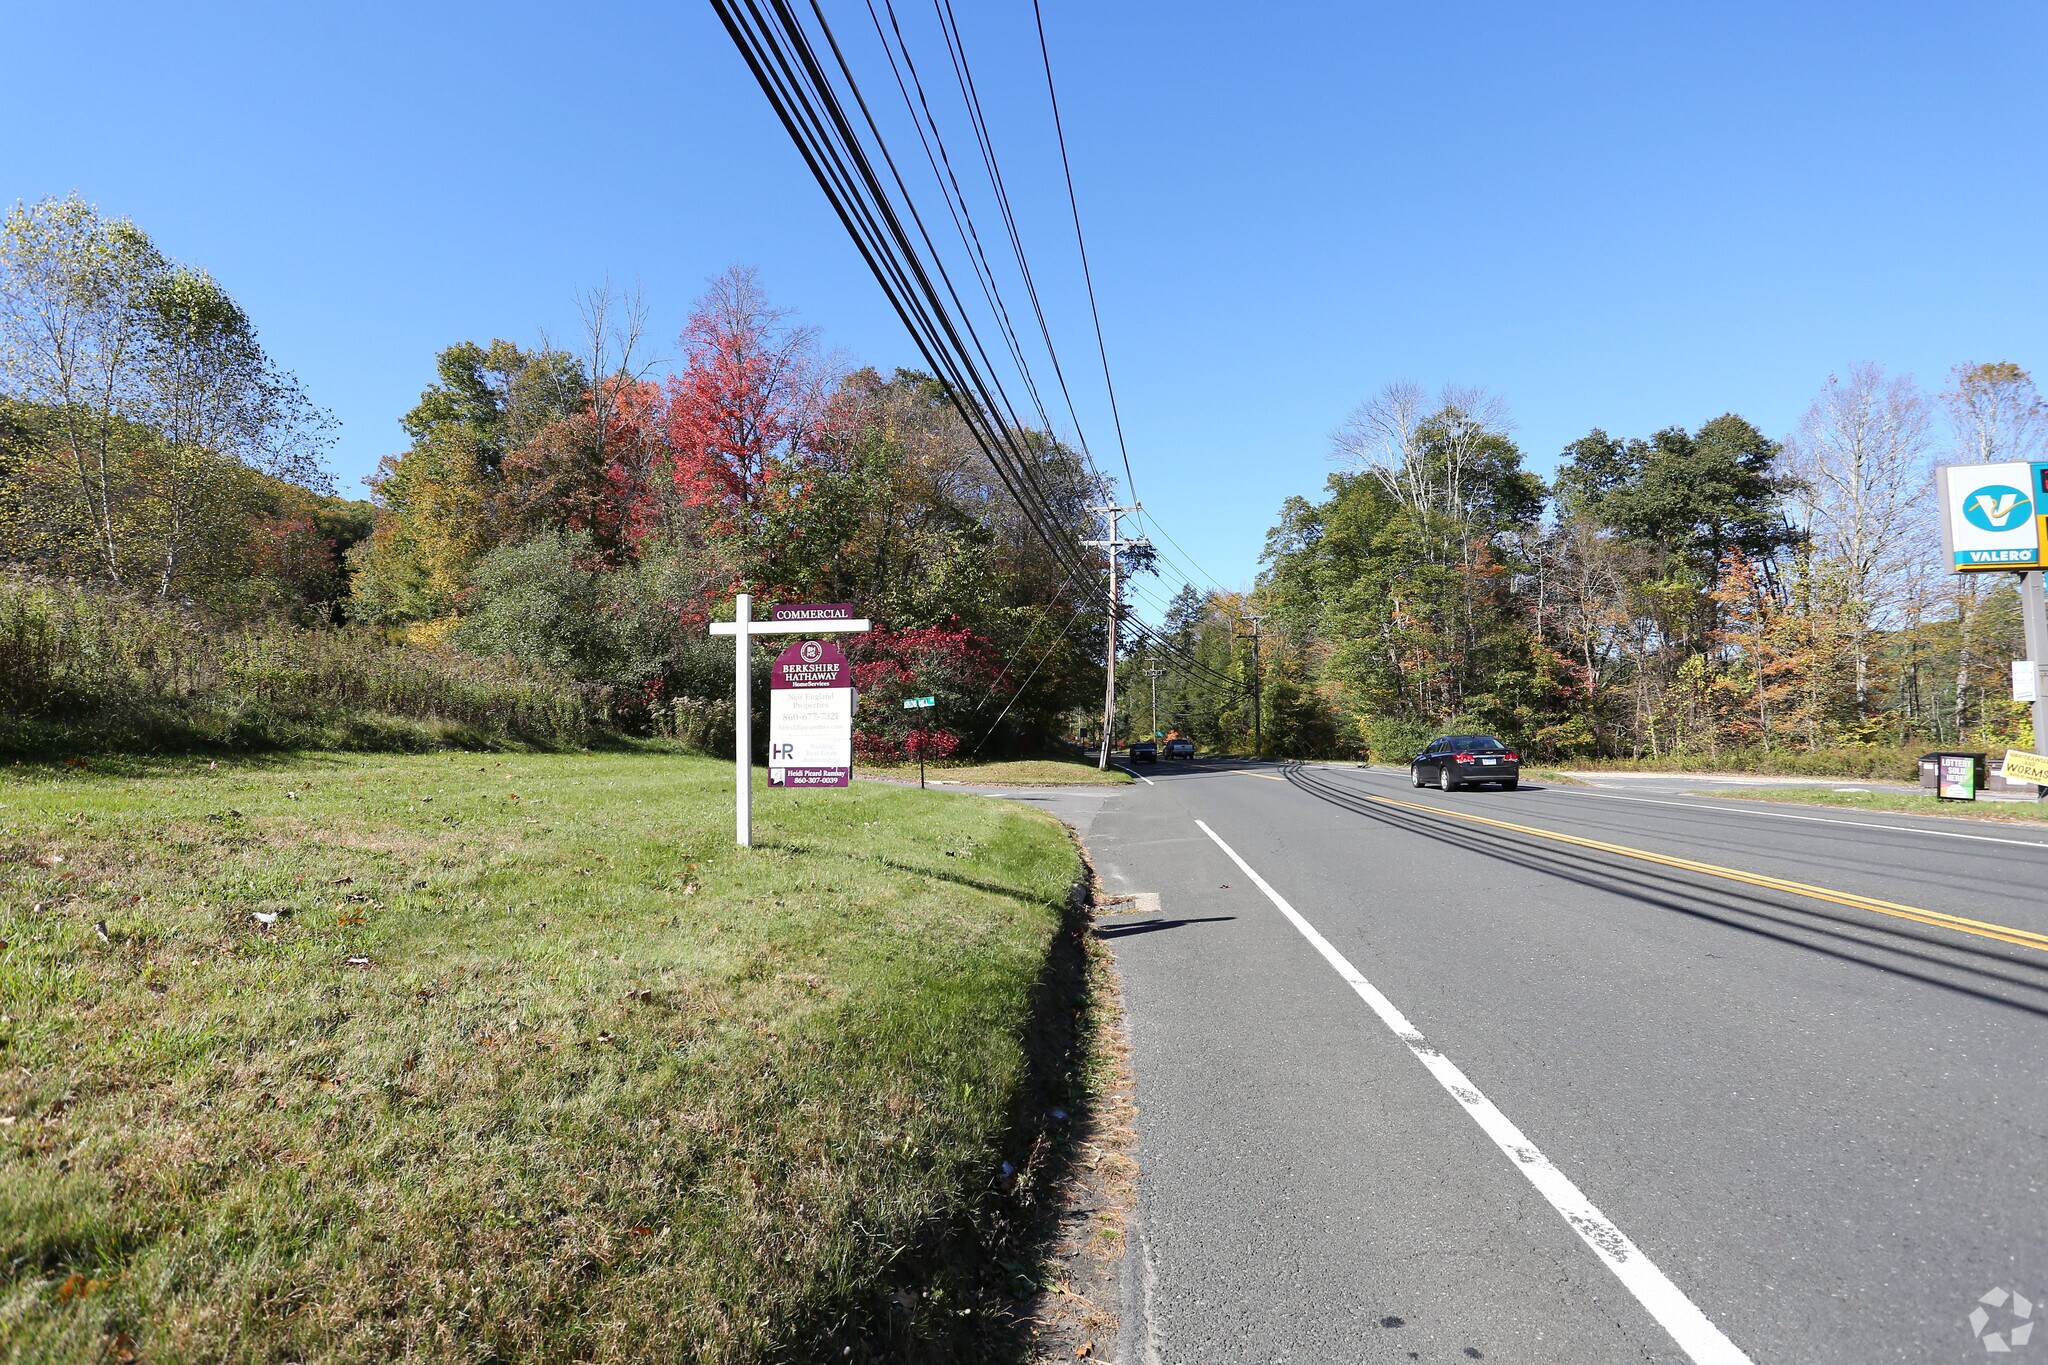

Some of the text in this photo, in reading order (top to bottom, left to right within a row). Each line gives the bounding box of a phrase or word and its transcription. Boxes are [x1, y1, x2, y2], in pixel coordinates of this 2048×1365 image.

[1969, 549, 2032, 562] VALERO
[776, 609, 848, 620] COMMERCIAL
[782, 663, 840, 673] BERKSHIRE
[785, 672, 838, 681] HATHAWAY
[788, 692, 834, 702] New England
[793, 702, 829, 710] Properties
[782, 712, 839, 721] 860-677-7321
[773, 743, 794, 760] HR
[1941, 758, 1972, 768] LOTTERY
[1947, 766, 1966, 775] SOLD
[2006, 763, 2048, 779] WORMS
